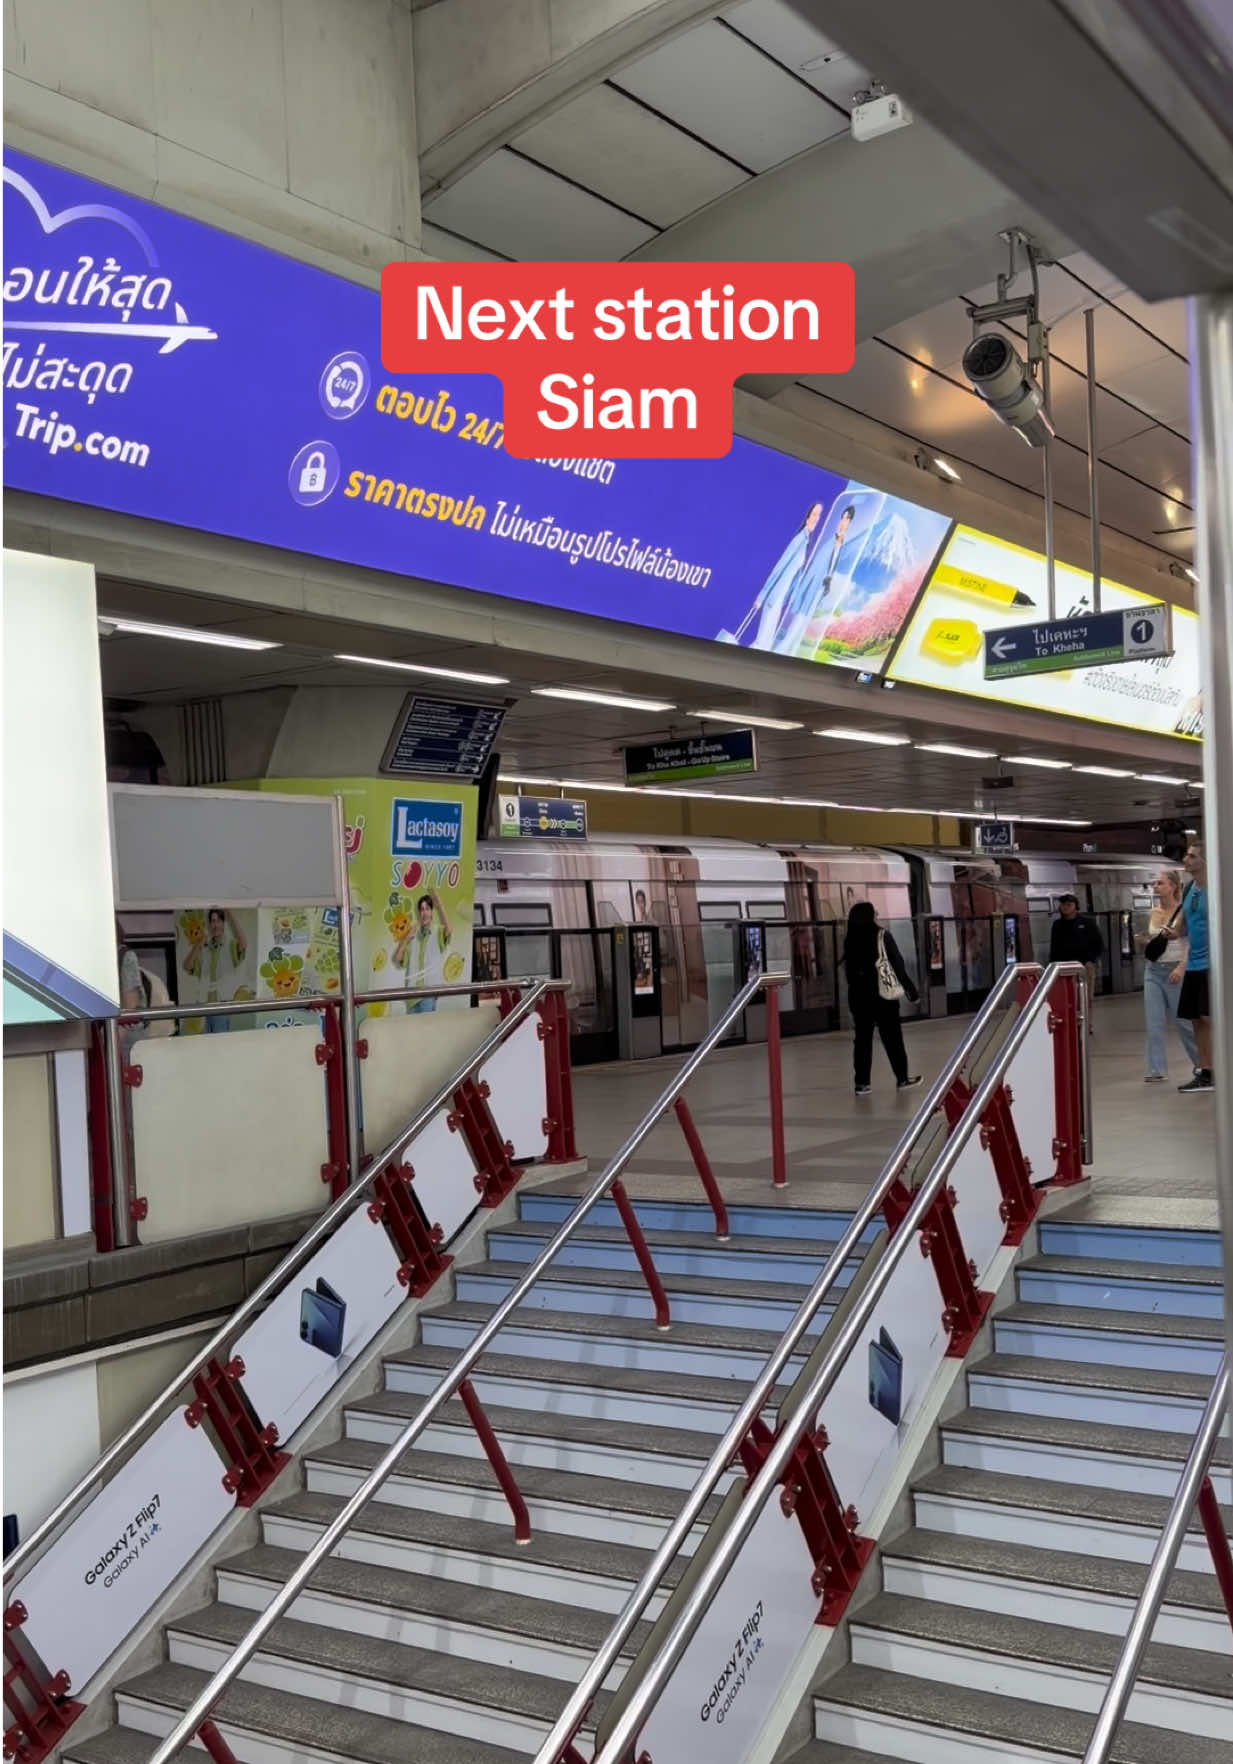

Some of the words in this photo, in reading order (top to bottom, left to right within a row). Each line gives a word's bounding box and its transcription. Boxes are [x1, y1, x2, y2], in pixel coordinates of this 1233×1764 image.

[334, 377, 356, 391] 24/7
[376, 385, 456, 432] ตอบไว
[16, 403, 150, 467] Trip.com
[345, 471, 485, 529] ราคาตรงปก
[490, 501, 711, 588] ไม่เหมือนรูปโปรไฟล์น้องเขา
[1032, 626, 1088, 645] ไปเคหะฯ
[1035, 647, 1049, 658] To
[1051, 641, 1085, 655] Kheha
[396, 806, 459, 848] Lactasoy
[476, 859, 504, 872] 3134
[85, 1533, 129, 1585] Galaxy
[126, 1523, 137, 1538] Z
[135, 1494, 161, 1528] Flip7
[104, 1545, 139, 1588] Galaxy
[140, 1532, 151, 1549] AI
[700, 1653, 737, 1722] Galaxy
[735, 1639, 744, 1658] Z
[742, 1600, 763, 1645] Flip7
[716, 1667, 746, 1724] Galaxy
[745, 1650, 755, 1671] AI
